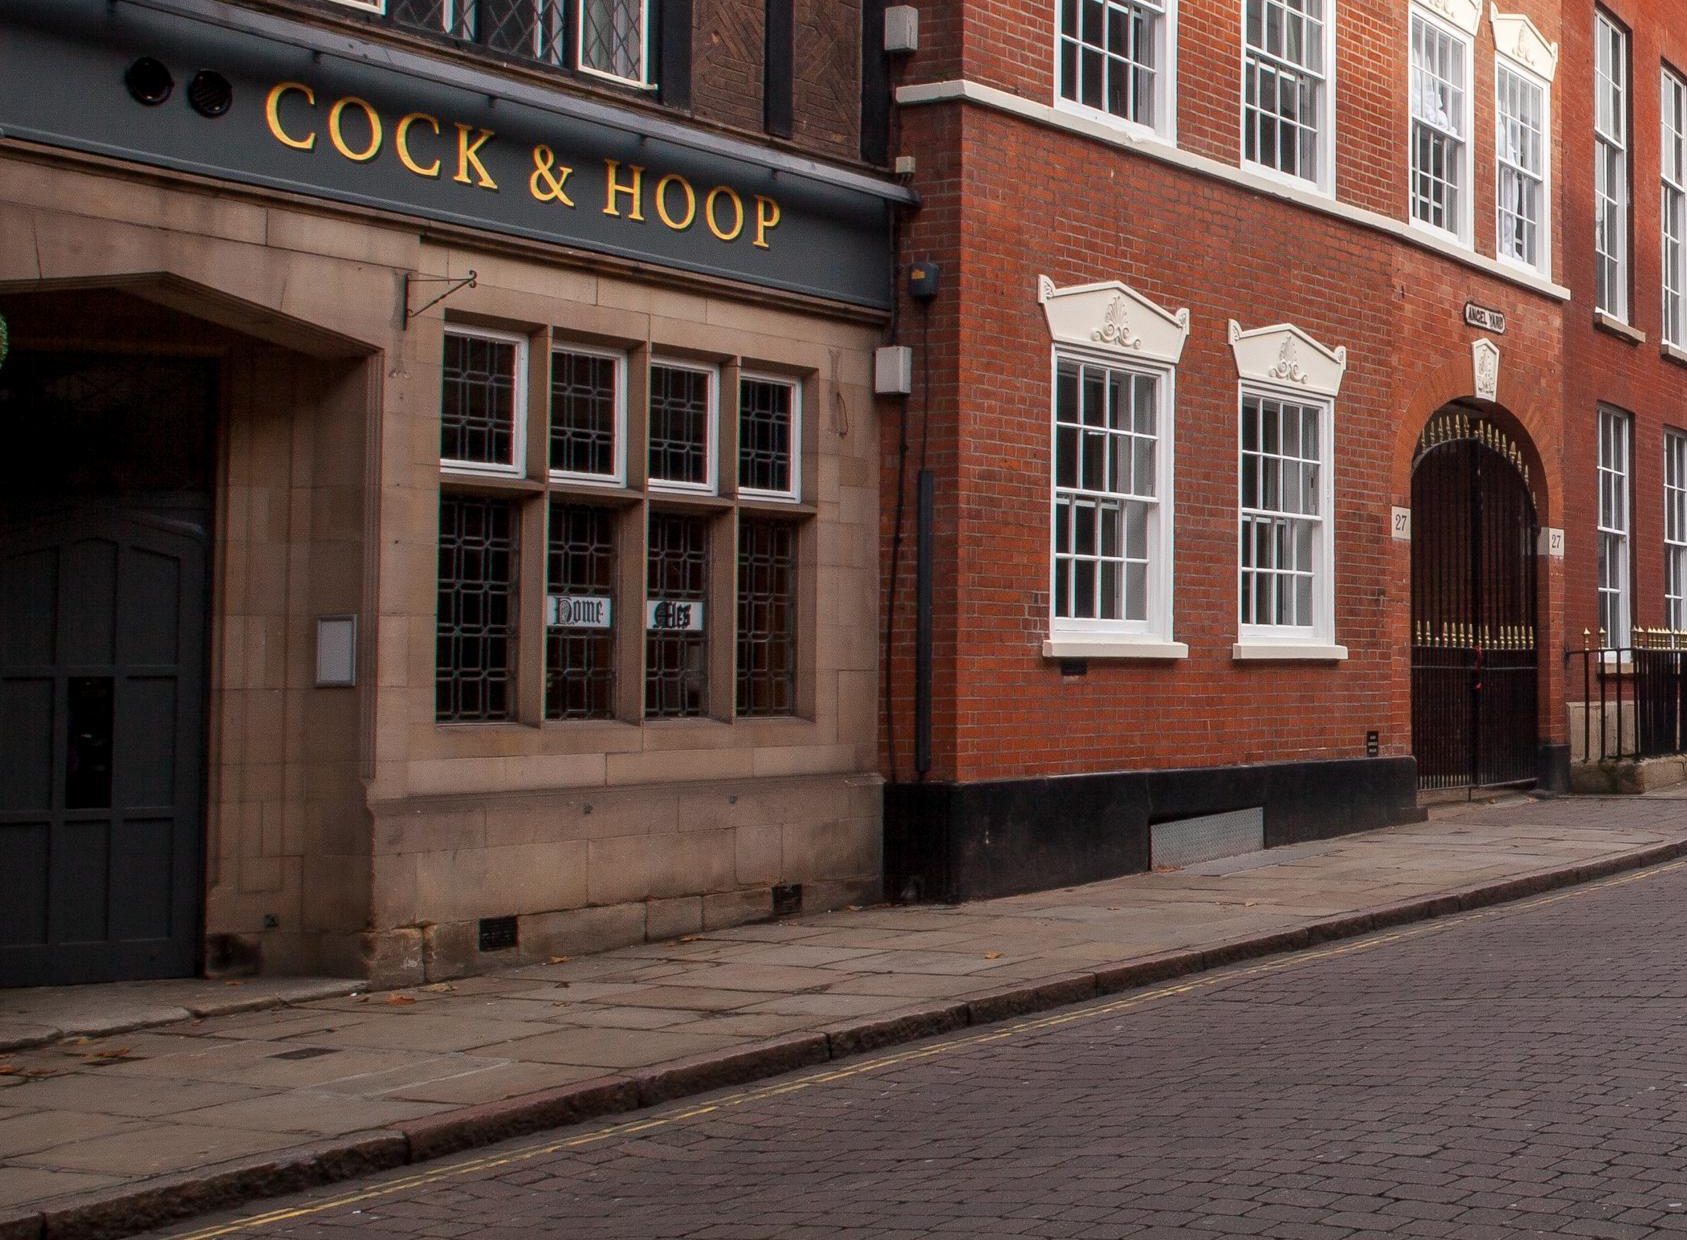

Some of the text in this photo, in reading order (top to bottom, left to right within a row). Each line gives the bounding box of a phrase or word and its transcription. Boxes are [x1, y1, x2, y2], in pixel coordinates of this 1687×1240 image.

[265, 82, 782, 248] COCK & HOOP
[1468, 306, 1504, 329] ANGEL YARD
[1395, 514, 1407, 531] 27
[1551, 534, 1561, 549] 27
[554, 596, 604, 625] Home
